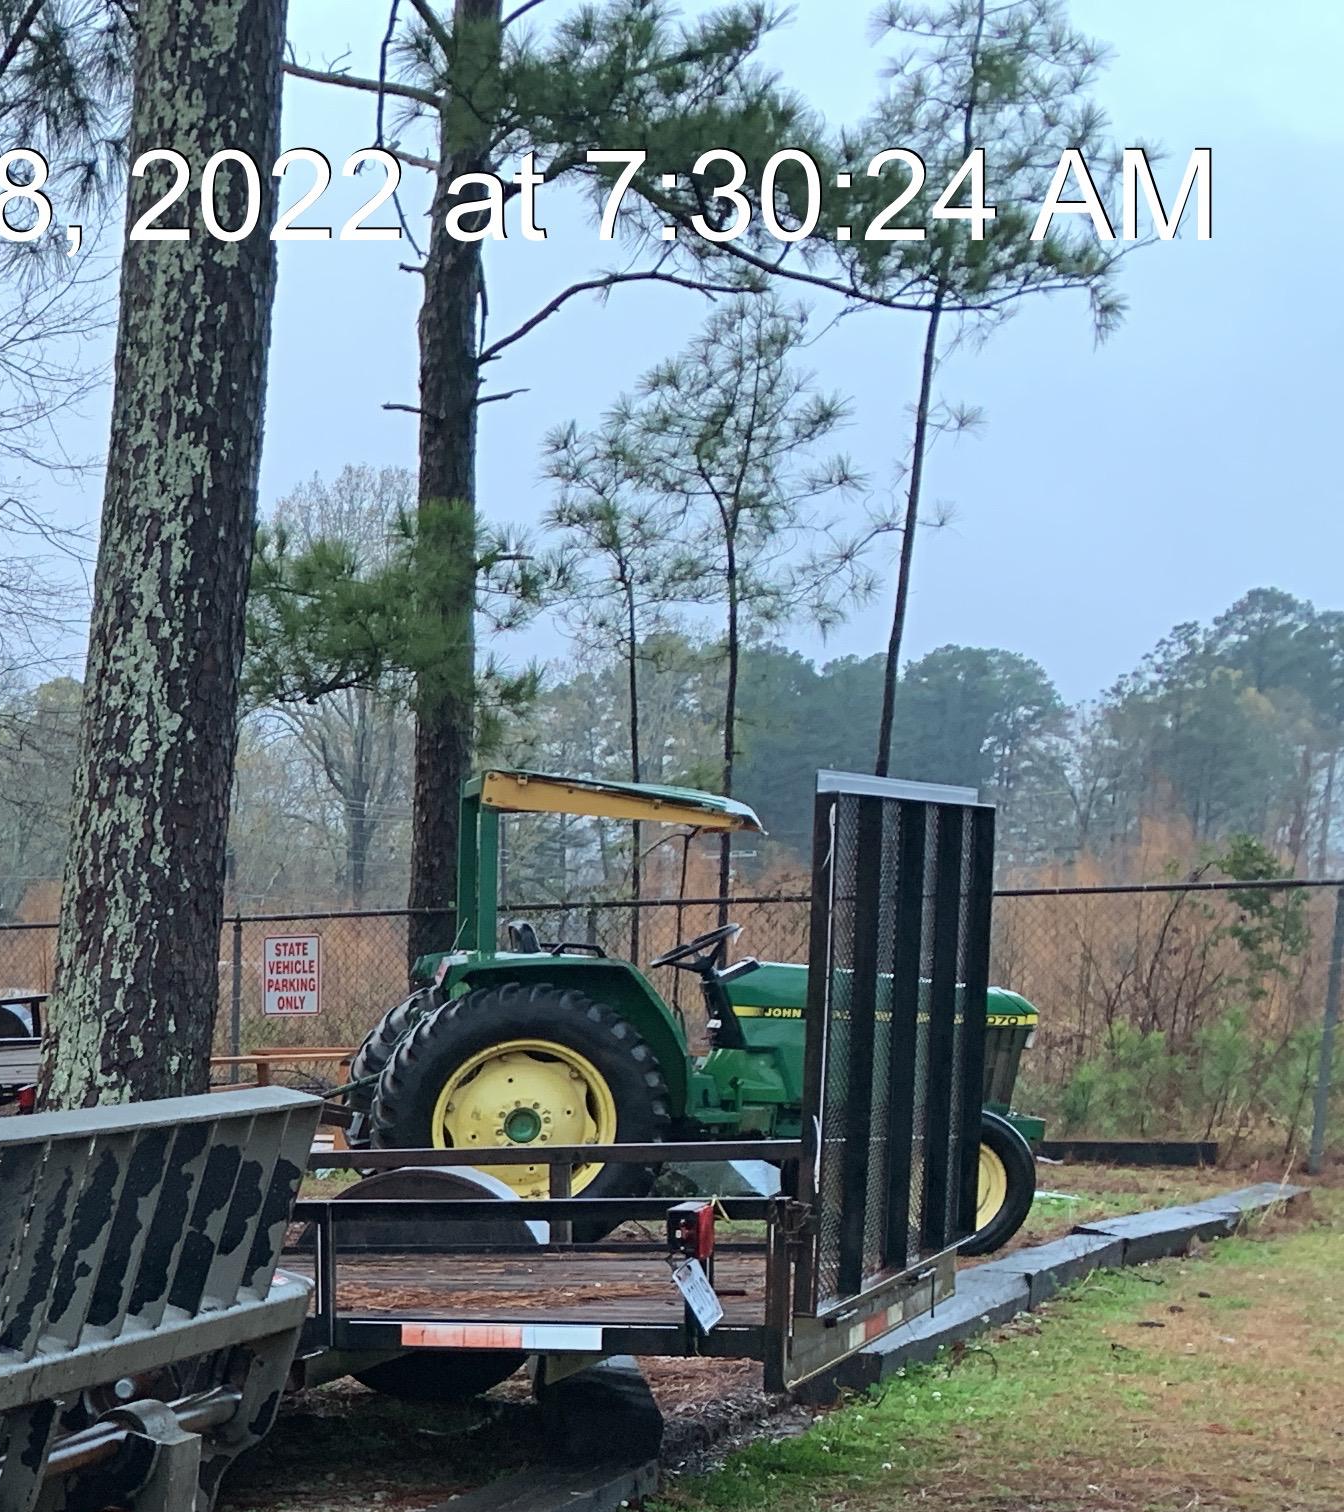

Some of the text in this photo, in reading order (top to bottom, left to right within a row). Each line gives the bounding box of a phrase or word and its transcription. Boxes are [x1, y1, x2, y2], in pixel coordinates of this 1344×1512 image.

[275, 942, 309, 957] STATE
[268, 960, 315, 975] VEHICLE
[267, 978, 316, 993] PARKING
[277, 995, 306, 1010] ONLY
[764, 1007, 802, 1018] JOHN
